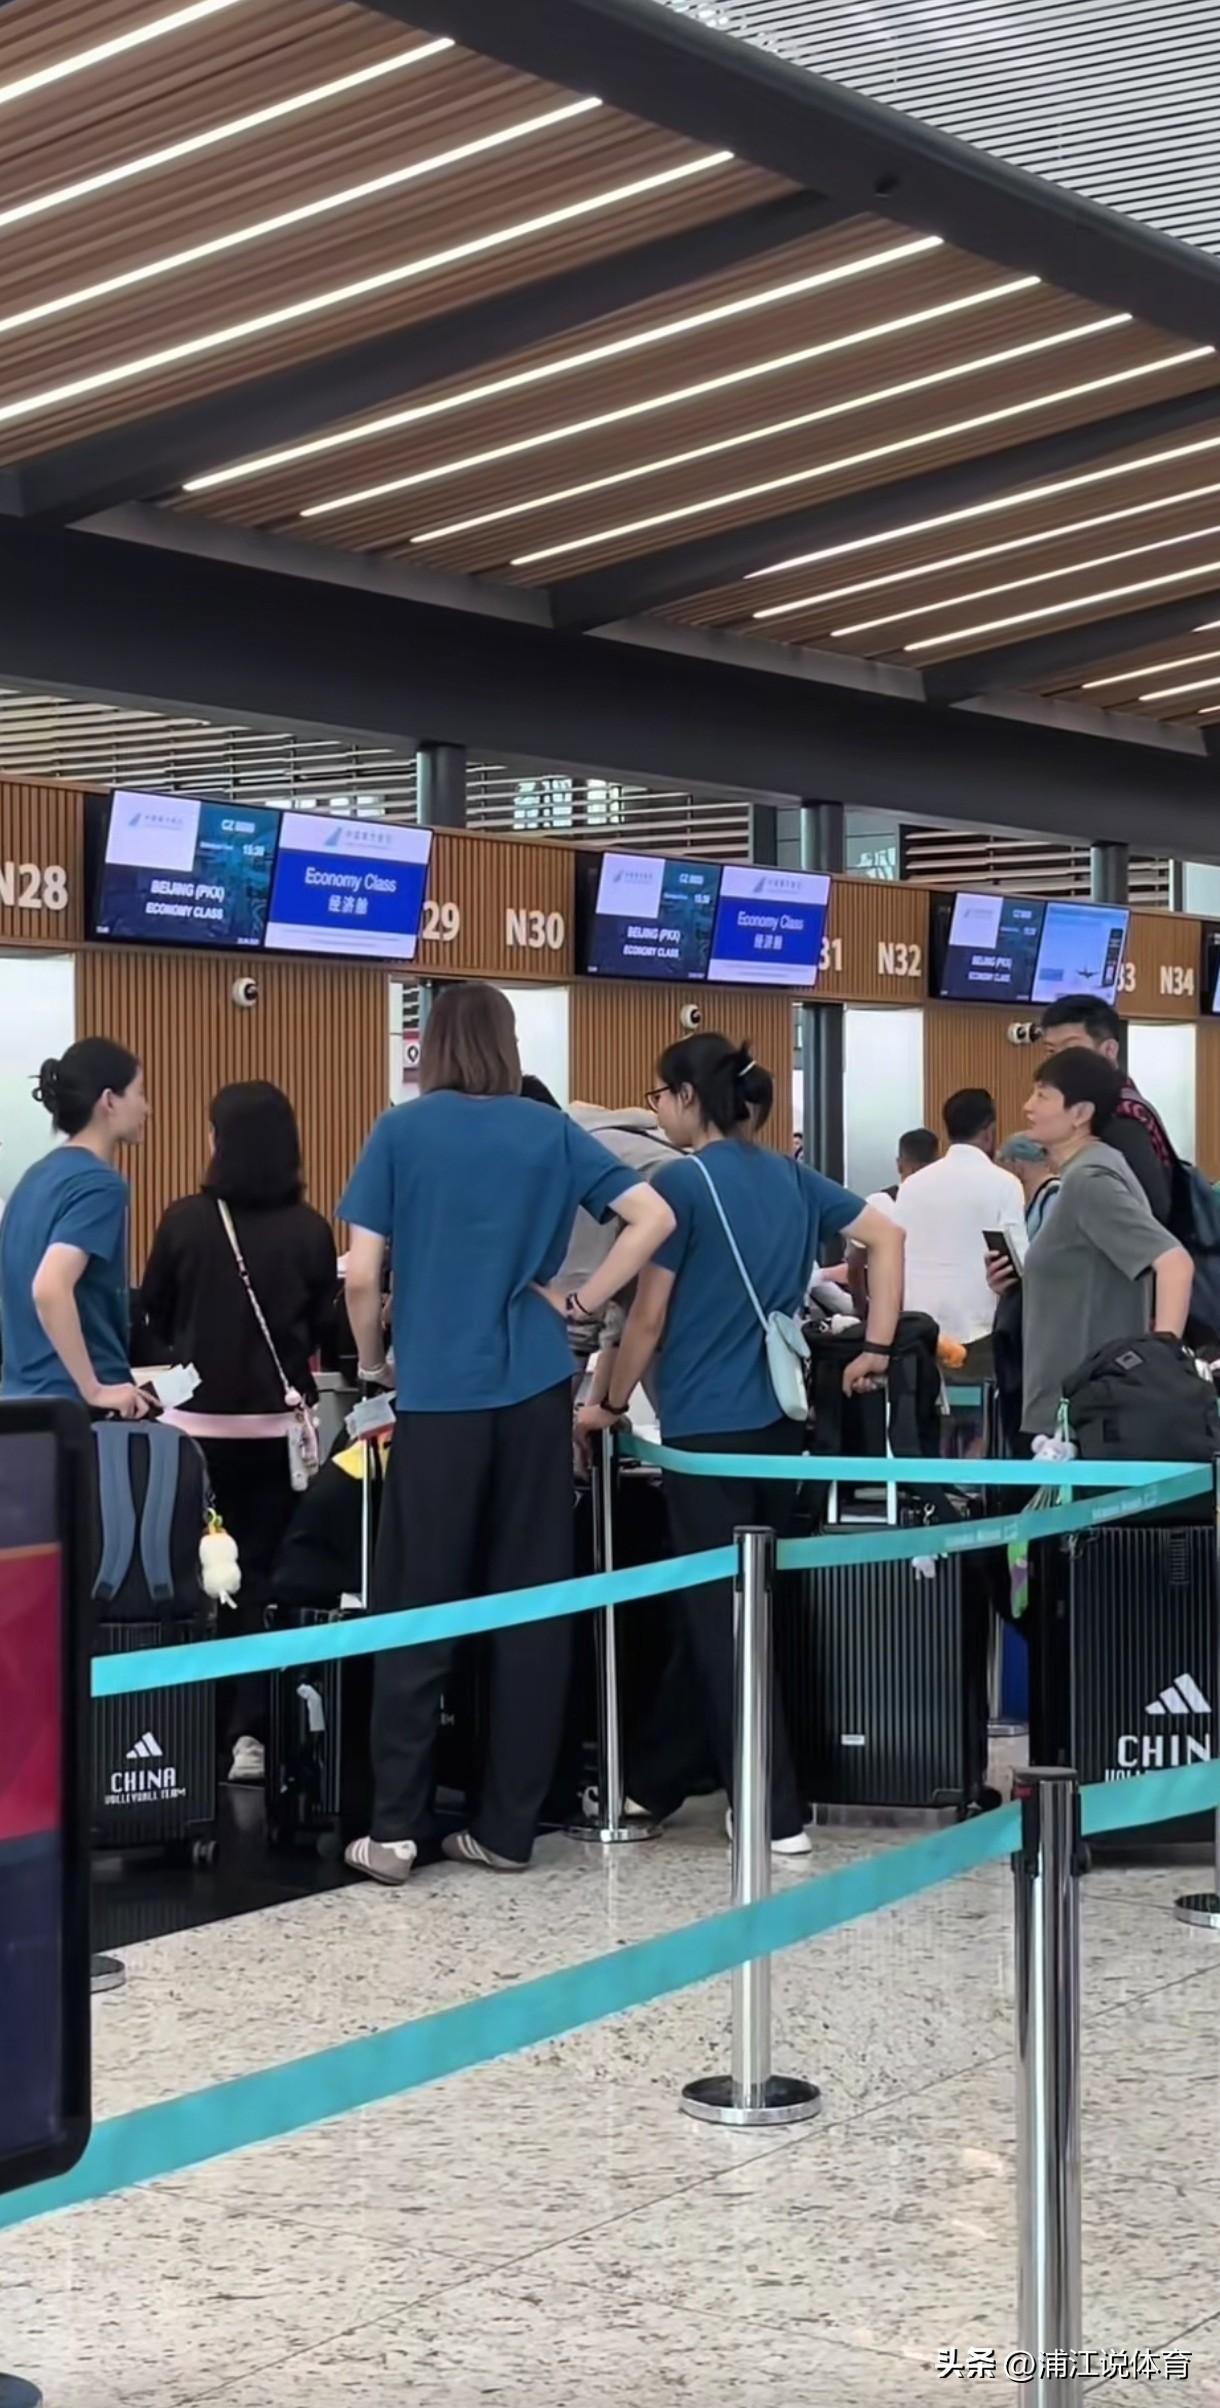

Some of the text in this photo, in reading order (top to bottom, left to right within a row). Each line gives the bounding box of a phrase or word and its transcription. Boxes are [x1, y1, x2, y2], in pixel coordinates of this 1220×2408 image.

[0, 861, 68, 911] N28
[150, 879, 194, 897] BEIJING
[305, 866, 397, 893] Economy Class
[145, 902, 224, 920] ECONOMY CLASS
[737, 910, 779, 931] Economy
[506, 908, 565, 949] N30
[878, 941, 922, 976] N32
[1160, 965, 1195, 996] N34
[111, 1767, 176, 1793] CHINA
